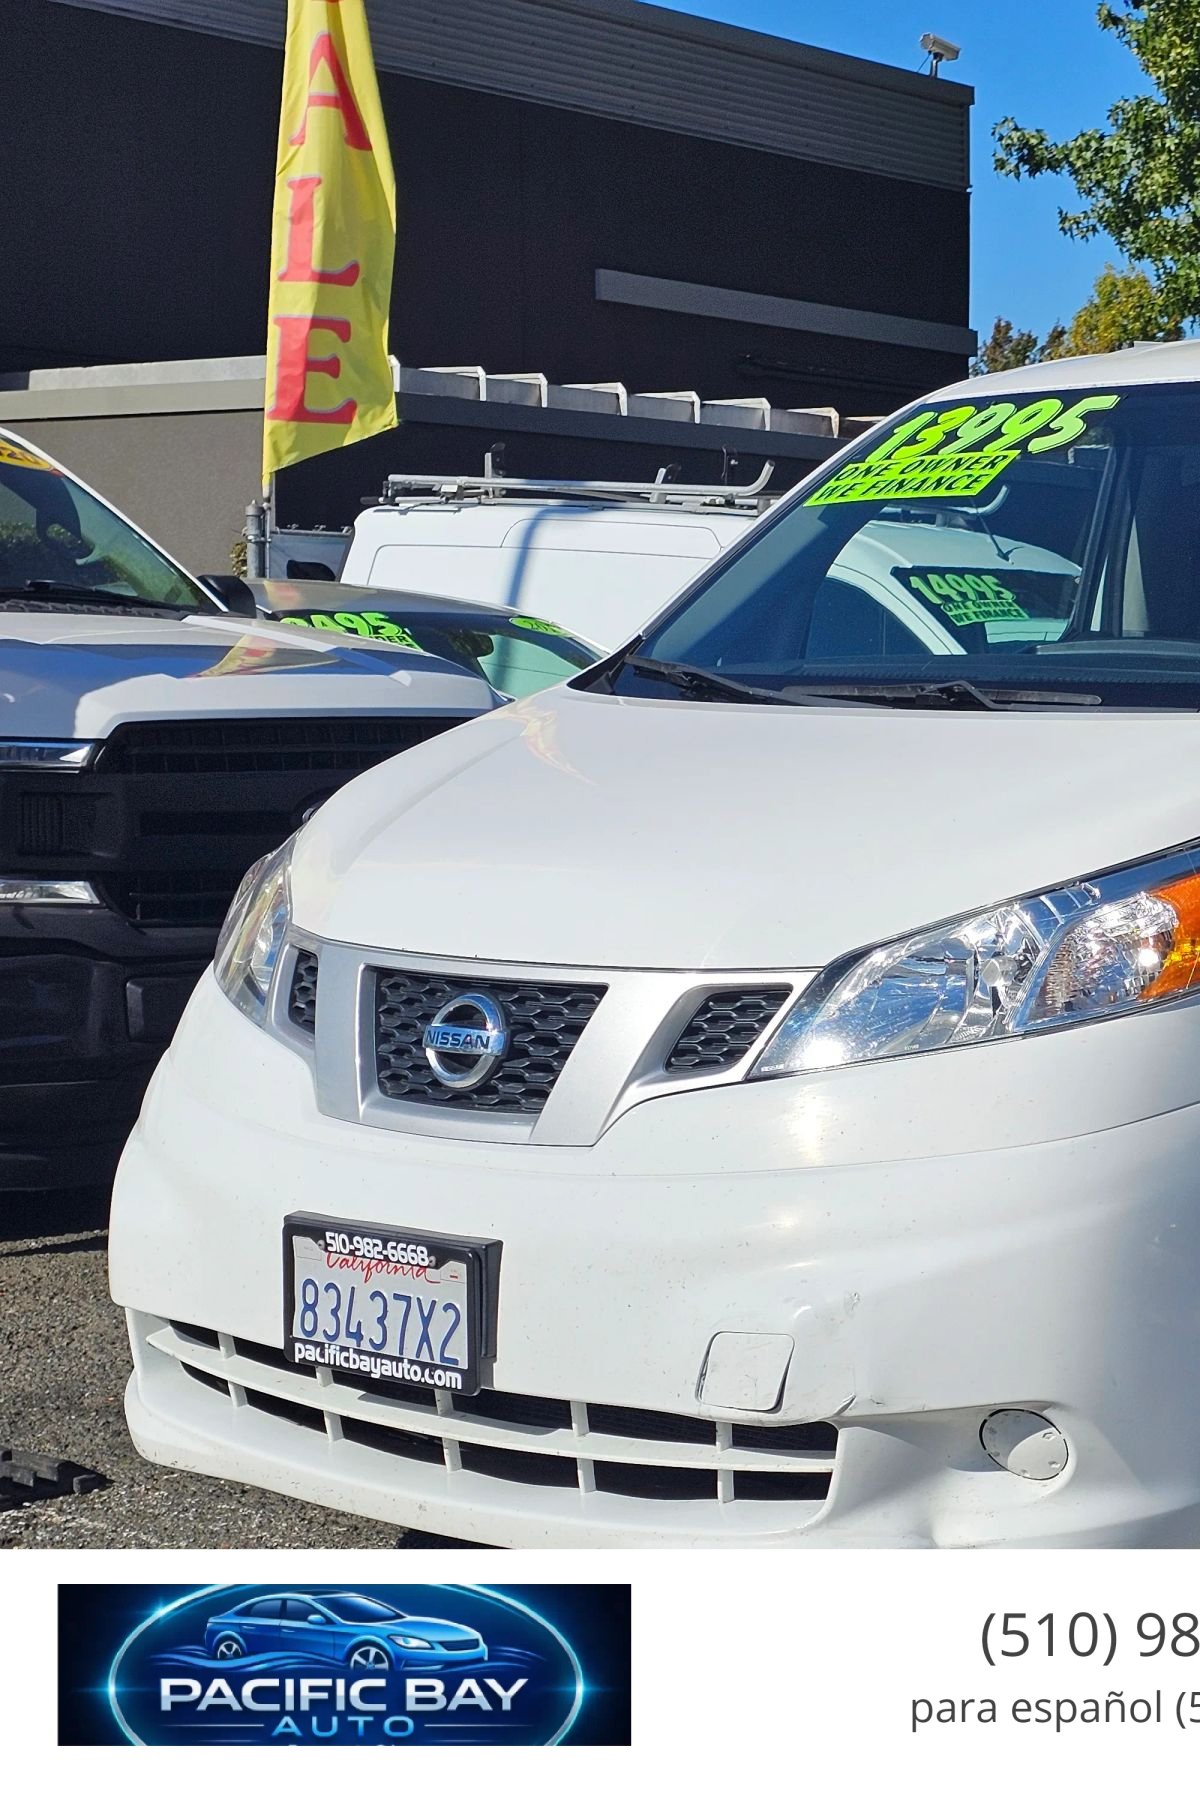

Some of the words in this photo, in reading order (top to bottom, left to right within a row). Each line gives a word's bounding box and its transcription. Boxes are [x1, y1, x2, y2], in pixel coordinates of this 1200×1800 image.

[267, 0, 373, 424] ALE
[865, 395, 1121, 463] 13995
[835, 462, 896, 482] ONE
[901, 455, 1009, 477] OWNER
[814, 480, 859, 500] WE
[863, 473, 989, 495] FINANCE
[909, 574, 1016, 605] 14995
[942, 601, 970, 613] ONE
[973, 600, 1018, 611] OWNER
[951, 613, 972, 624] WE
[975, 608, 1024, 622] FINANCE
[426, 1029, 491, 1049] NISSAN
[325, 1231, 429, 1266] 510-982-6668
[326, 1252, 441, 1284] California
[300, 1278, 462, 1366] 83437X2
[294, 1342, 463, 1391] pacificbayauto.com
